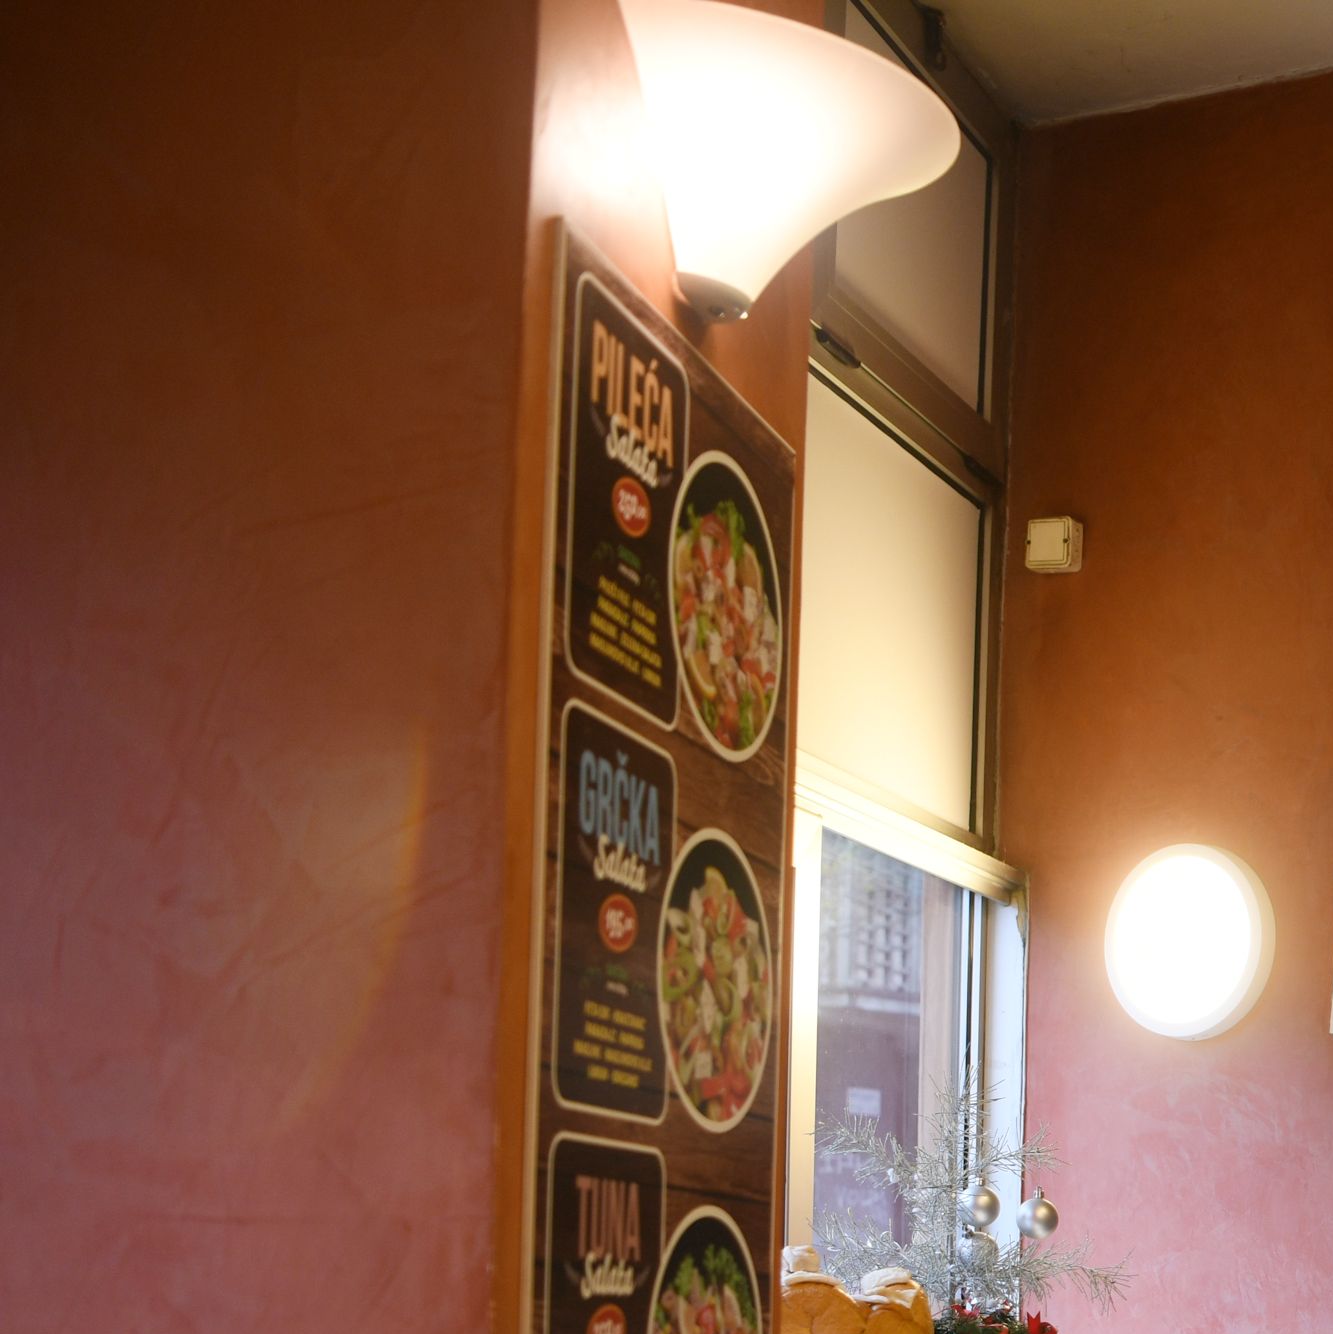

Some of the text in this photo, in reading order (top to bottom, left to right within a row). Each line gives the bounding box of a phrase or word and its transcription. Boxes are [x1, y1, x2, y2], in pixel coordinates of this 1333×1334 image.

[590, 318, 674, 471] PILEĆA
[605, 413, 659, 489] Salata
[578, 749, 661, 867] GRČKA
[592, 834, 649, 894] Salata
[575, 1174, 642, 1262] TUNA
[580, 1250, 636, 1301] Salata
